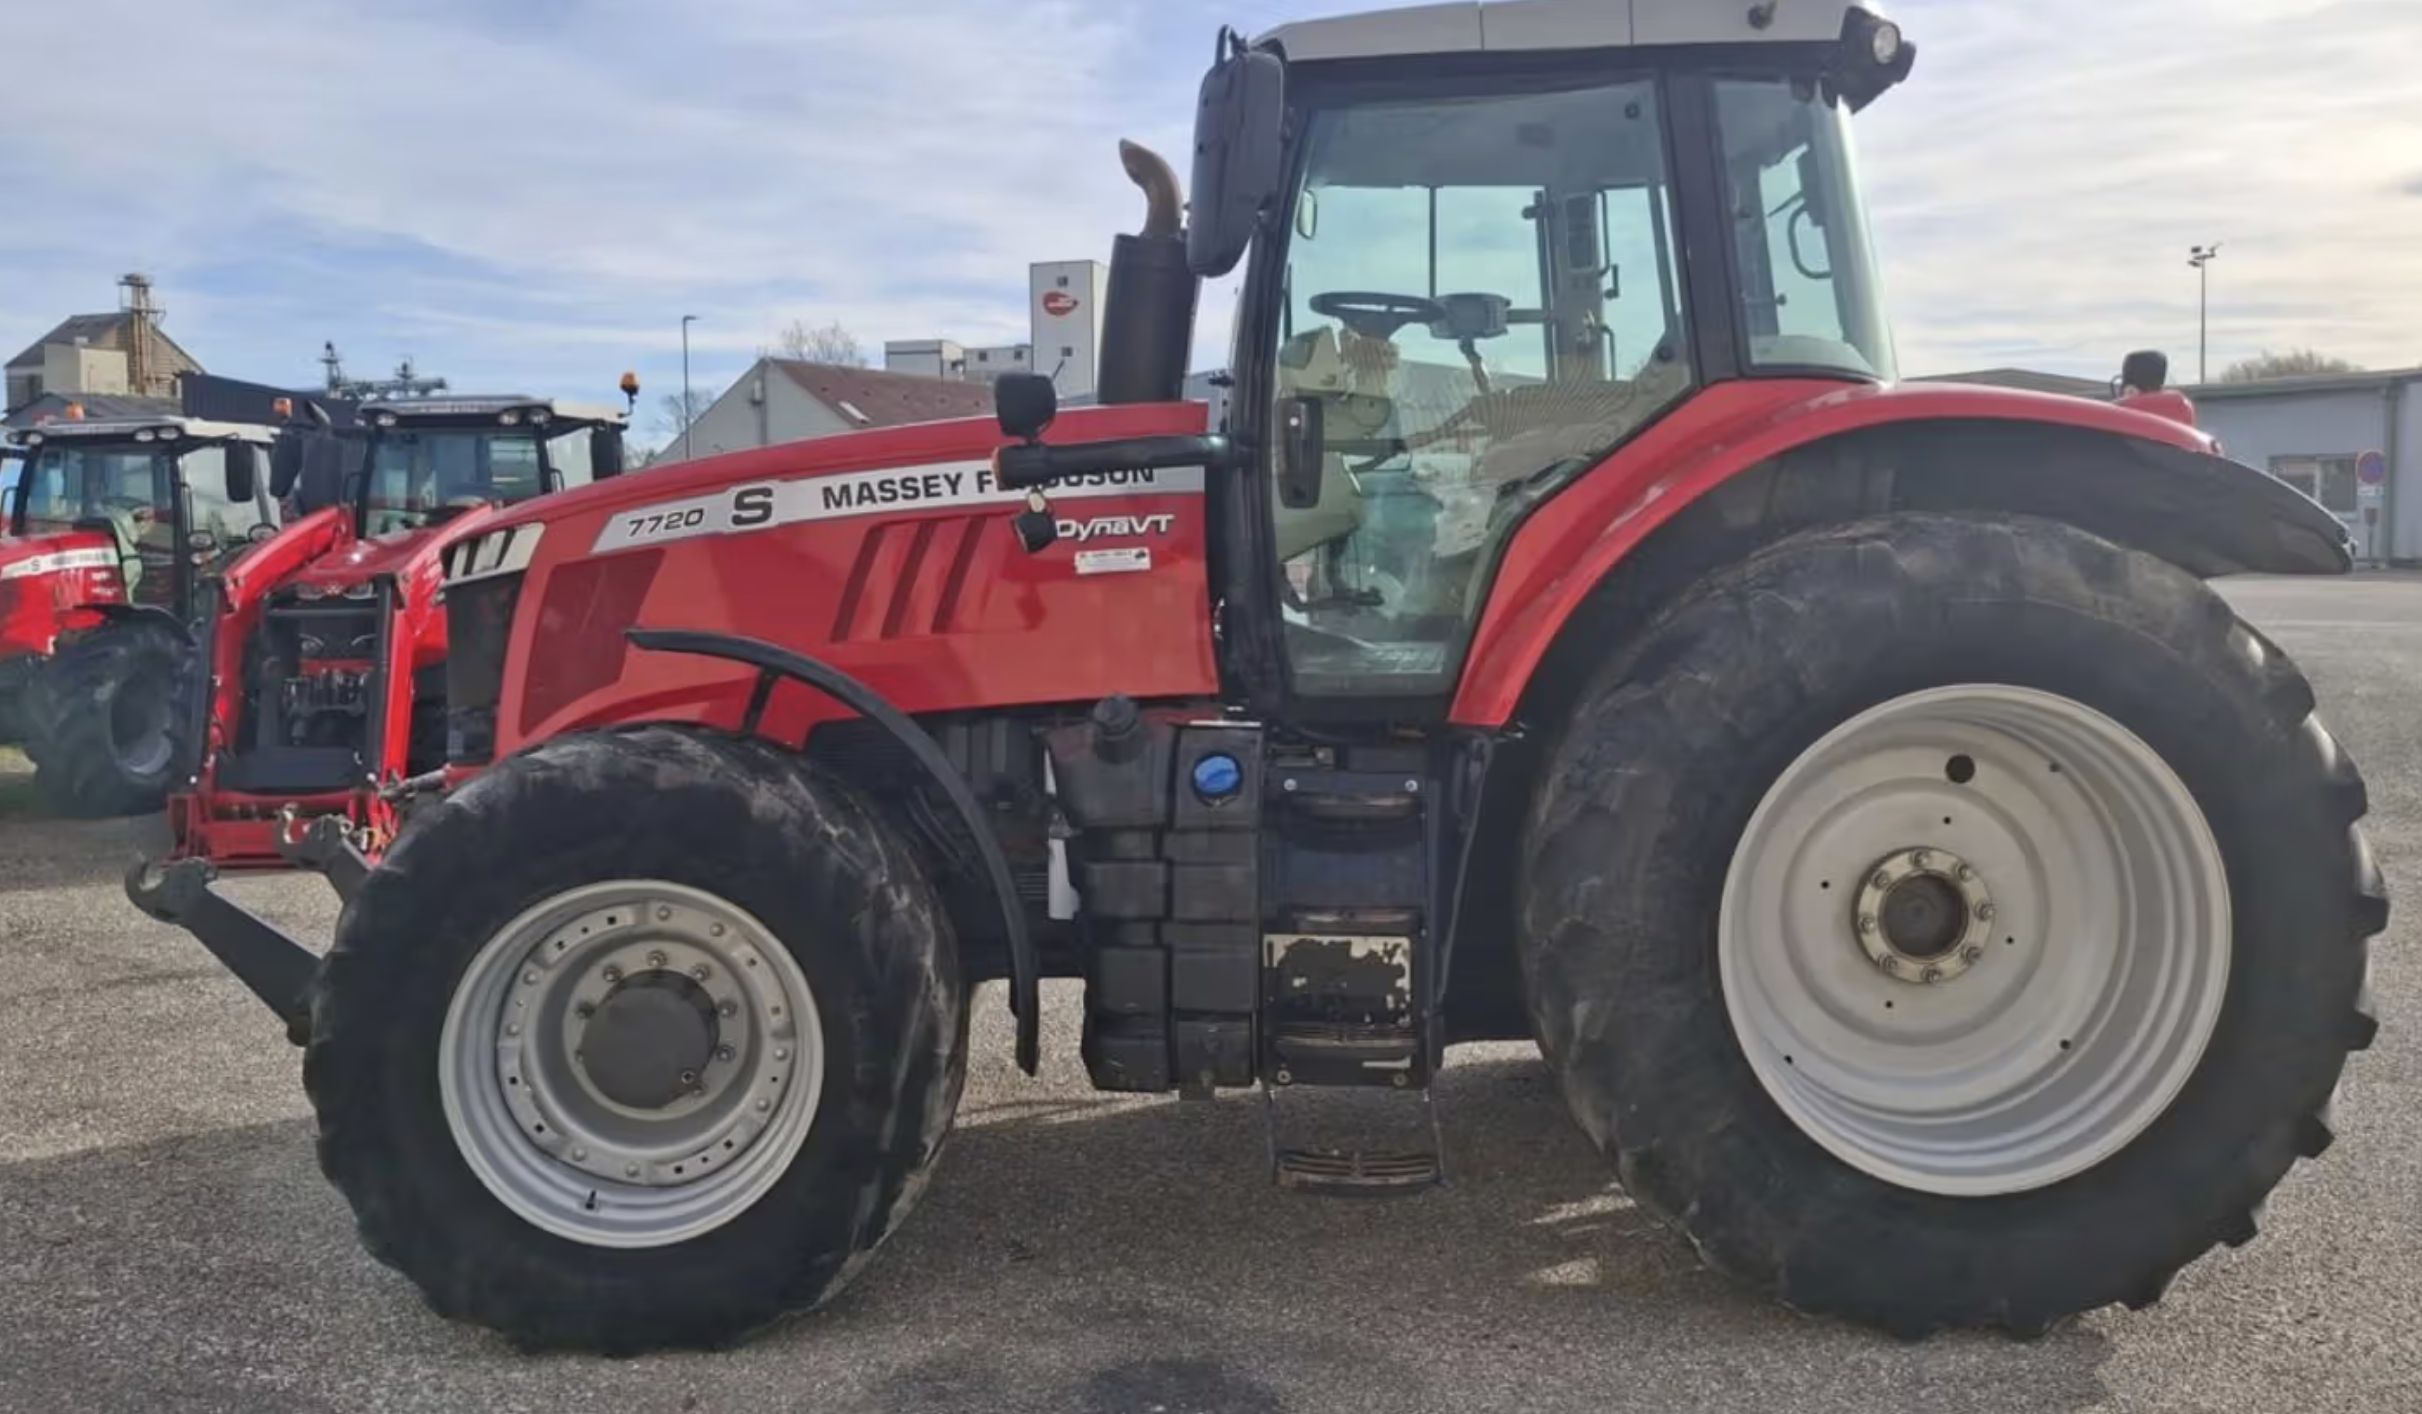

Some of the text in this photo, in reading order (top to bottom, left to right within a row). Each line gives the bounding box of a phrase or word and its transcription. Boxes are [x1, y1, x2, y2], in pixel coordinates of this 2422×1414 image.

[628, 508, 704, 537] 7720
[731, 487, 774, 527] S
[821, 472, 963, 510] MASSEY
[1055, 514, 1175, 542] DynaVT
